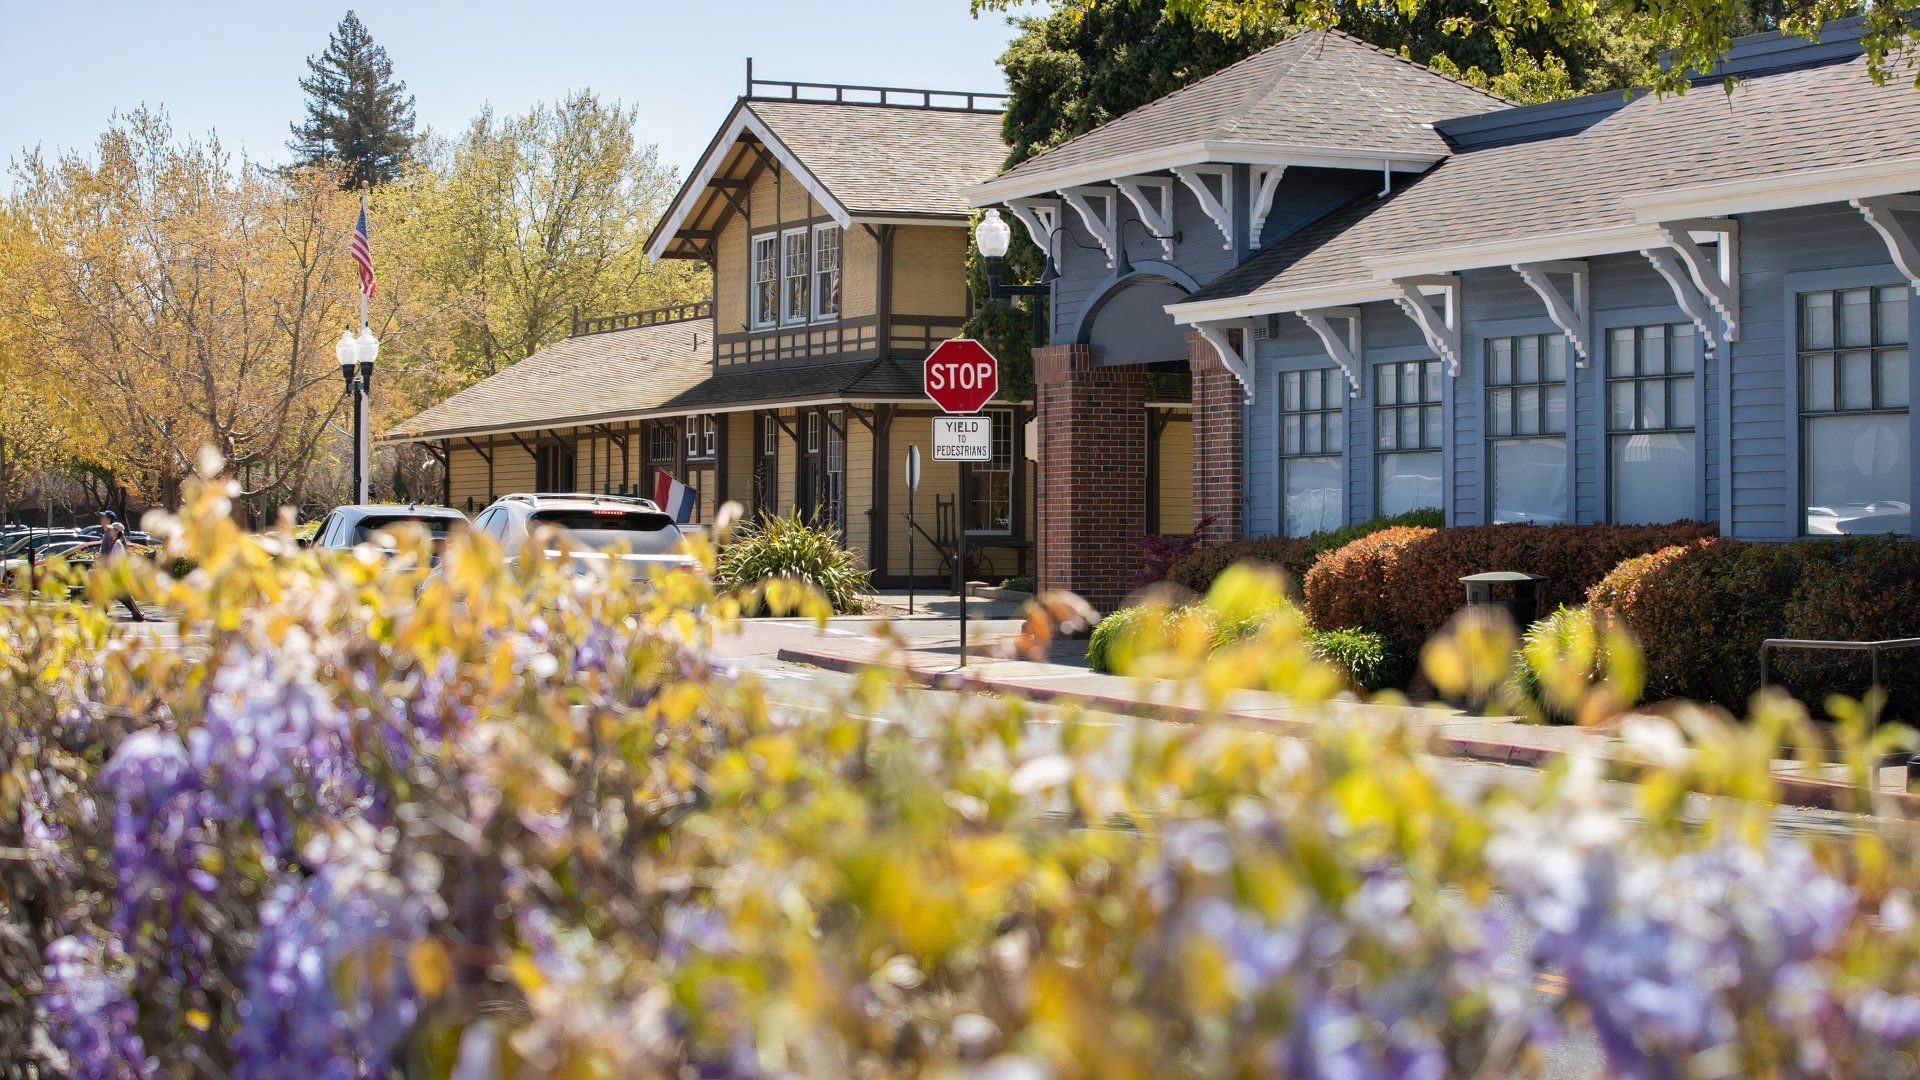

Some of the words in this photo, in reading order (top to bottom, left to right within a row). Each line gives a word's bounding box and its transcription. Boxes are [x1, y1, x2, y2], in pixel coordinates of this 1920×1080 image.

[930, 363, 992, 389] STOP
[946, 422, 978, 432] YIELD
[958, 435, 966, 443] TO
[937, 446, 987, 456] PEDESTRIANS
